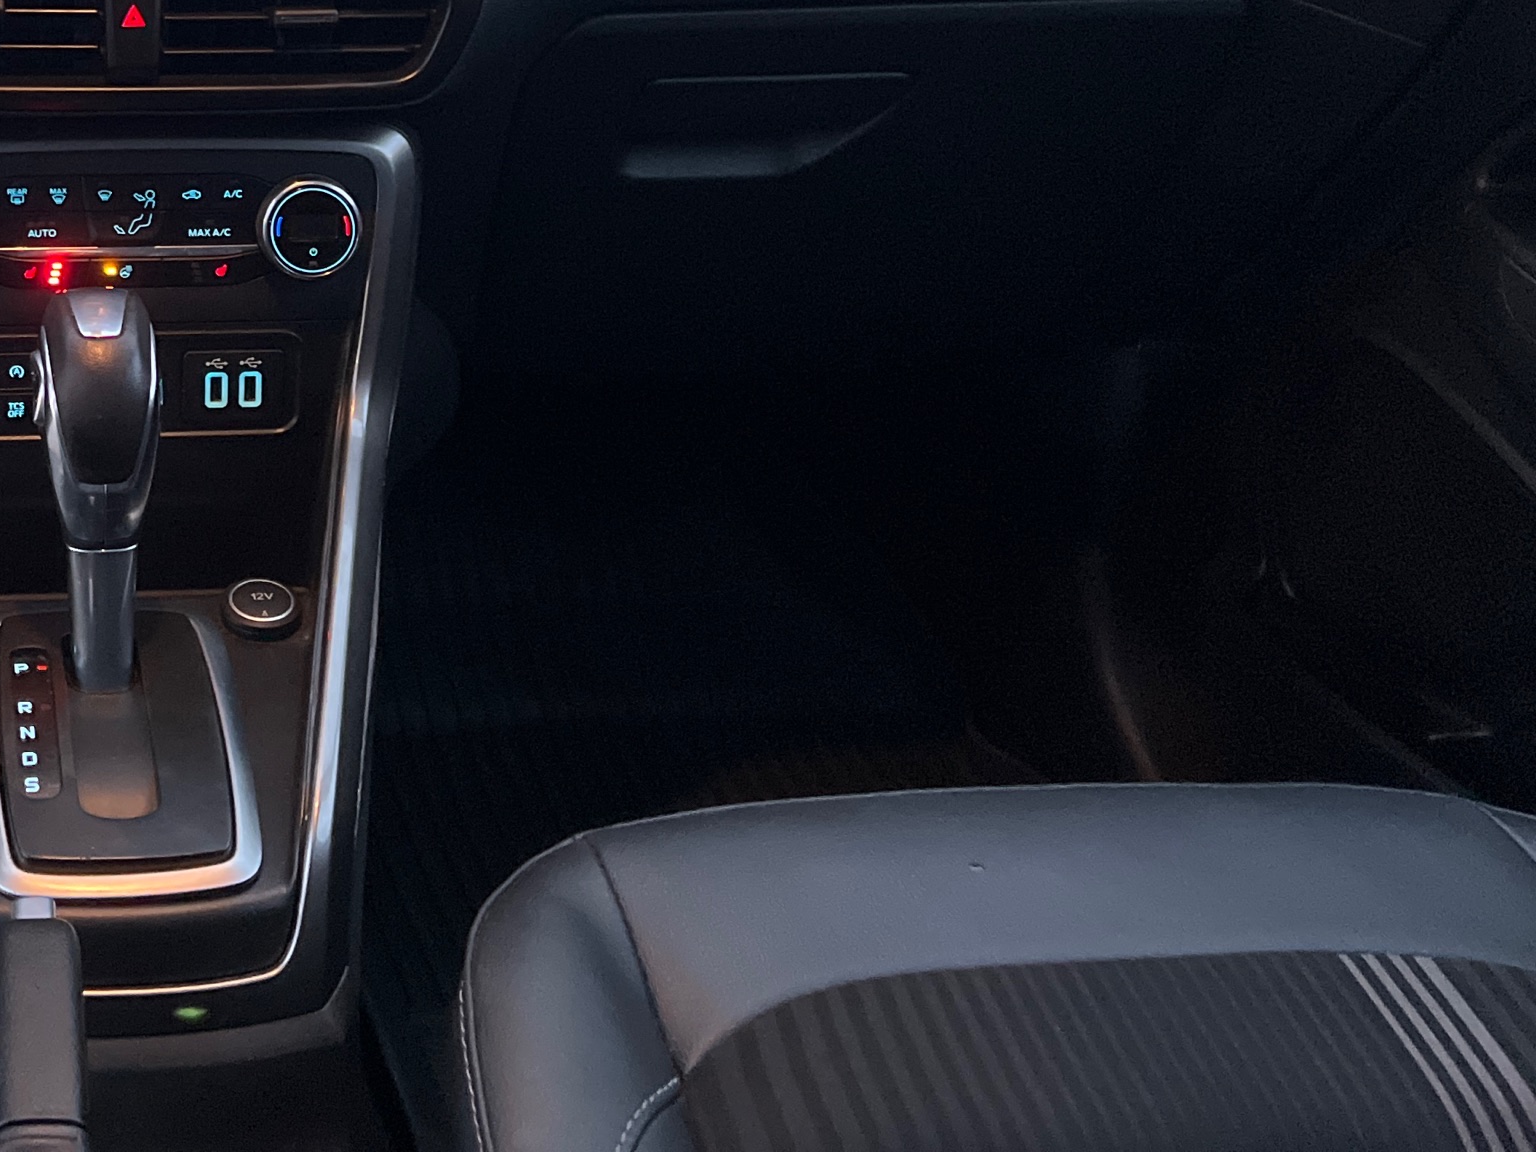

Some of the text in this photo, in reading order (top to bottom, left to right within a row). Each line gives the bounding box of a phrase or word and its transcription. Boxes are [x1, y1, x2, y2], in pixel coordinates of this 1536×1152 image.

[6, 187, 28, 195] REAR
[49, 187, 68, 195] MAX
[223, 189, 243, 199] A/C
[27, 228, 57, 238] AUTO
[188, 228, 232, 237] MAX A/C
[8, 401, 25, 410] TCS
[7, 409, 25, 418] OFF
[250, 592, 274, 601] 12V
[14, 663, 29, 675] P
[17, 701, 33, 714] R
[19, 725, 36, 740] N
[22, 751, 38, 767] D
[24, 777, 40, 793] S
